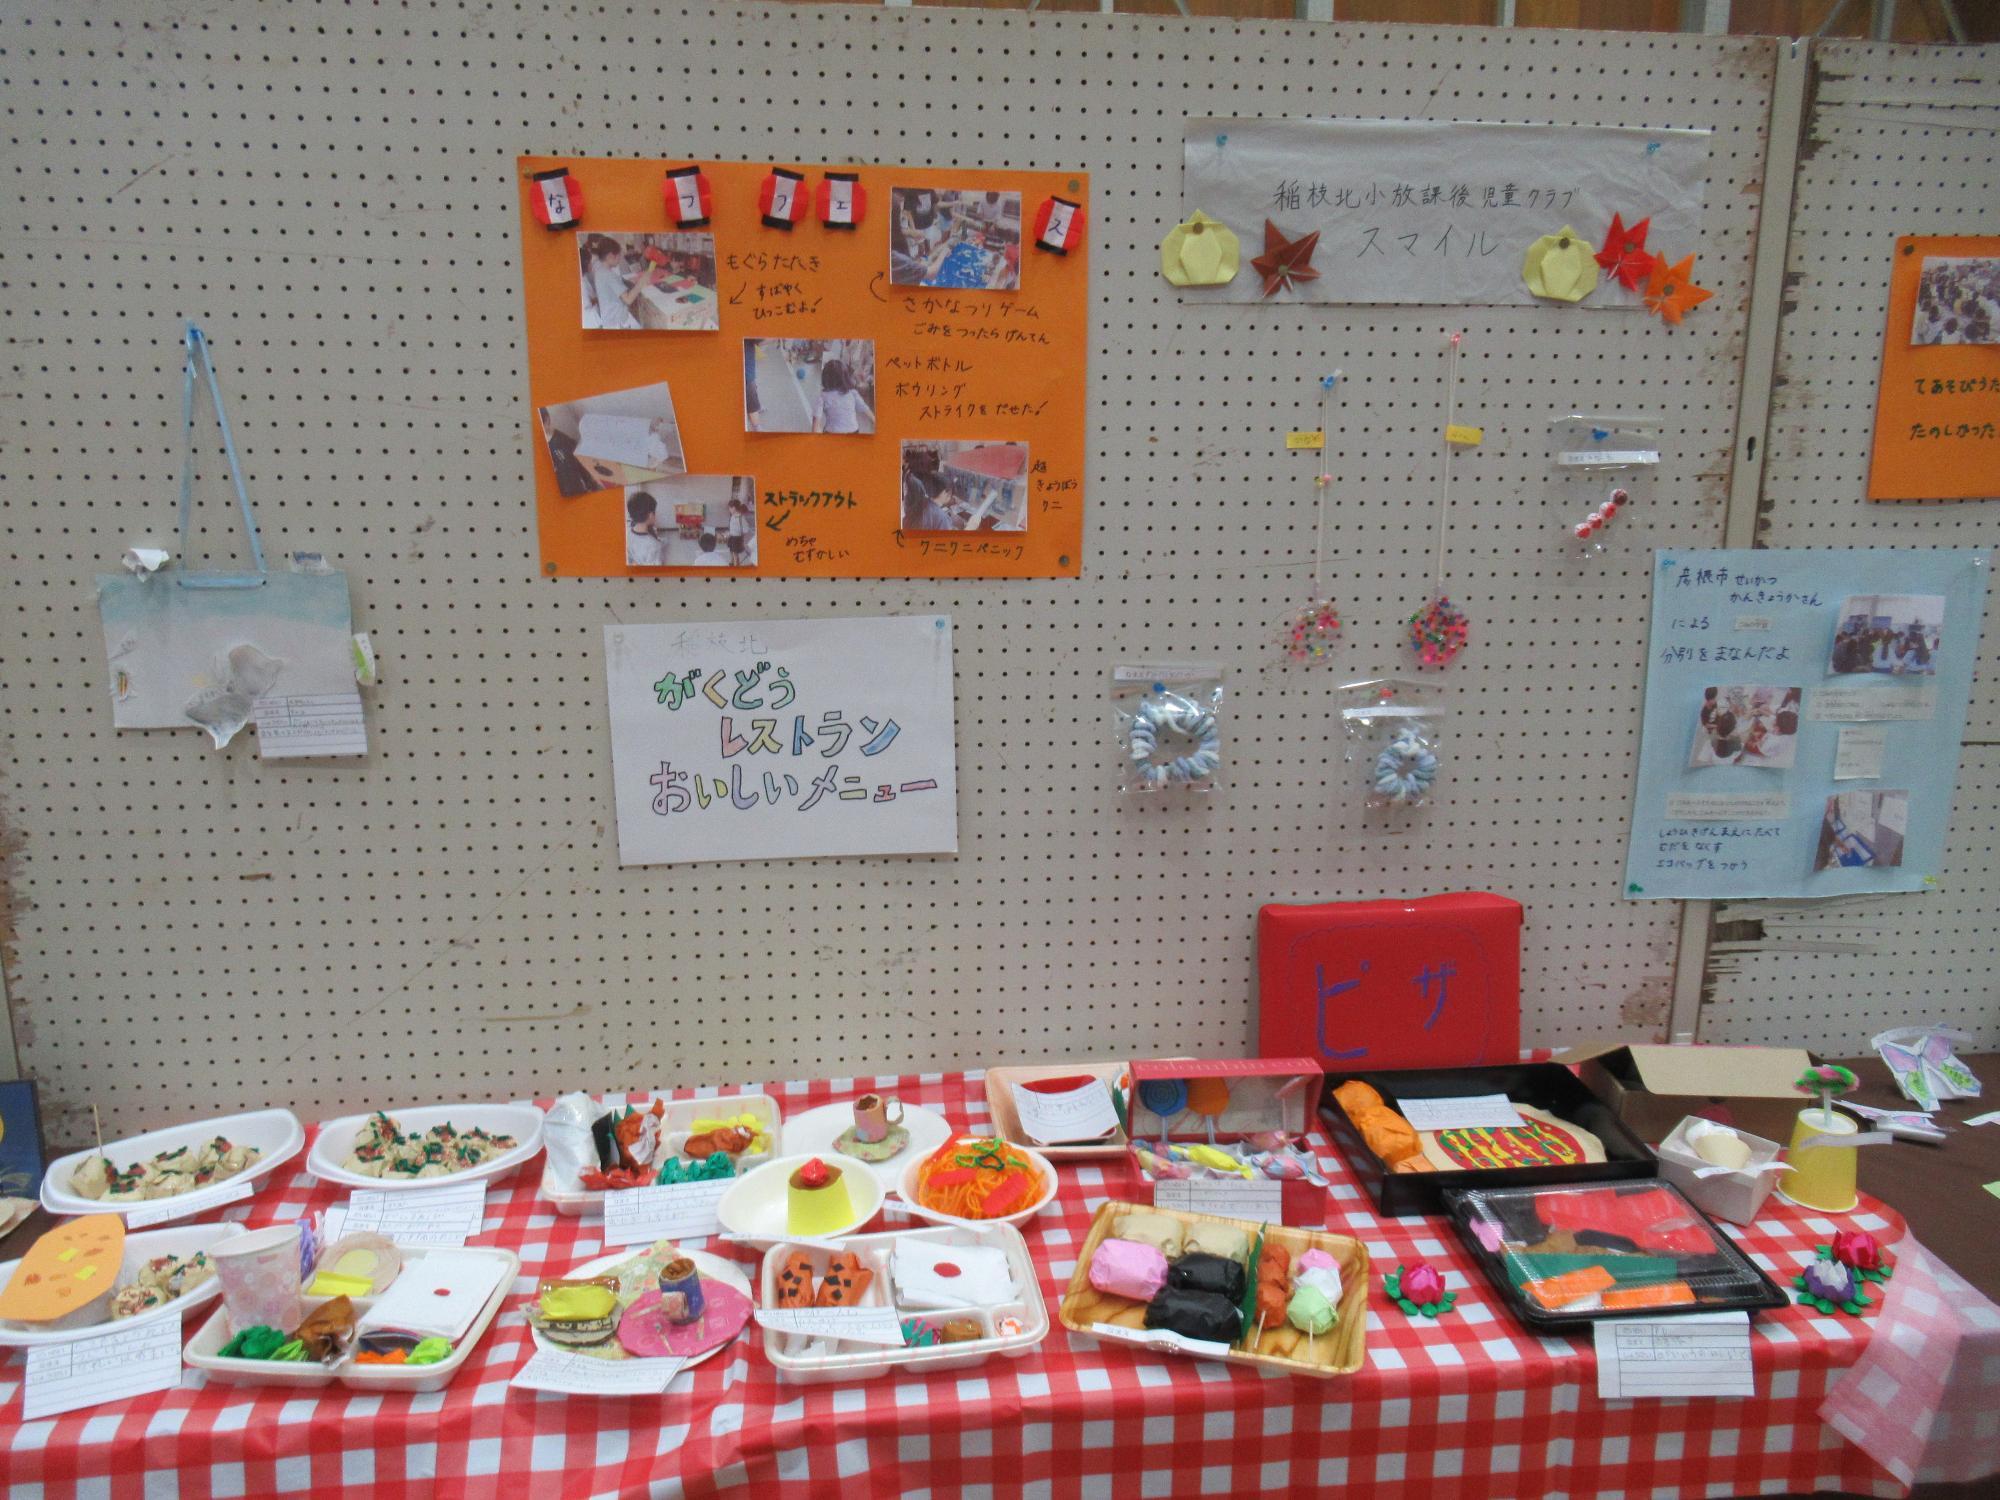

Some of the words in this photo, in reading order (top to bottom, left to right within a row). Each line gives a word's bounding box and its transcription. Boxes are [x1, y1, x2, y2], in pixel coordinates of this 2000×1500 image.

[1273, 178, 1580, 211] 稲枝北小放課後児童クラブ
[548, 193, 565, 213] な
[1048, 218, 1065, 236] ス
[1356, 224, 1500, 259] スマイル
[727, 252, 821, 273] もぐらたたき
[757, 282, 803, 300] すばやく
[885, 355, 973, 373] ペットボトル
[895, 382, 967, 399] ボウリング
[764, 489, 858, 510] ストラックアウト
[785, 535, 817, 547] めちゃ
[793, 548, 850, 563] むずかしい
[1671, 616, 1710, 630] による
[654, 661, 796, 711] がくどう
[721, 710, 901, 758] レストラン
[650, 760, 938, 816] おいしいメニュー
[1316, 959, 1457, 1059] ピザ
